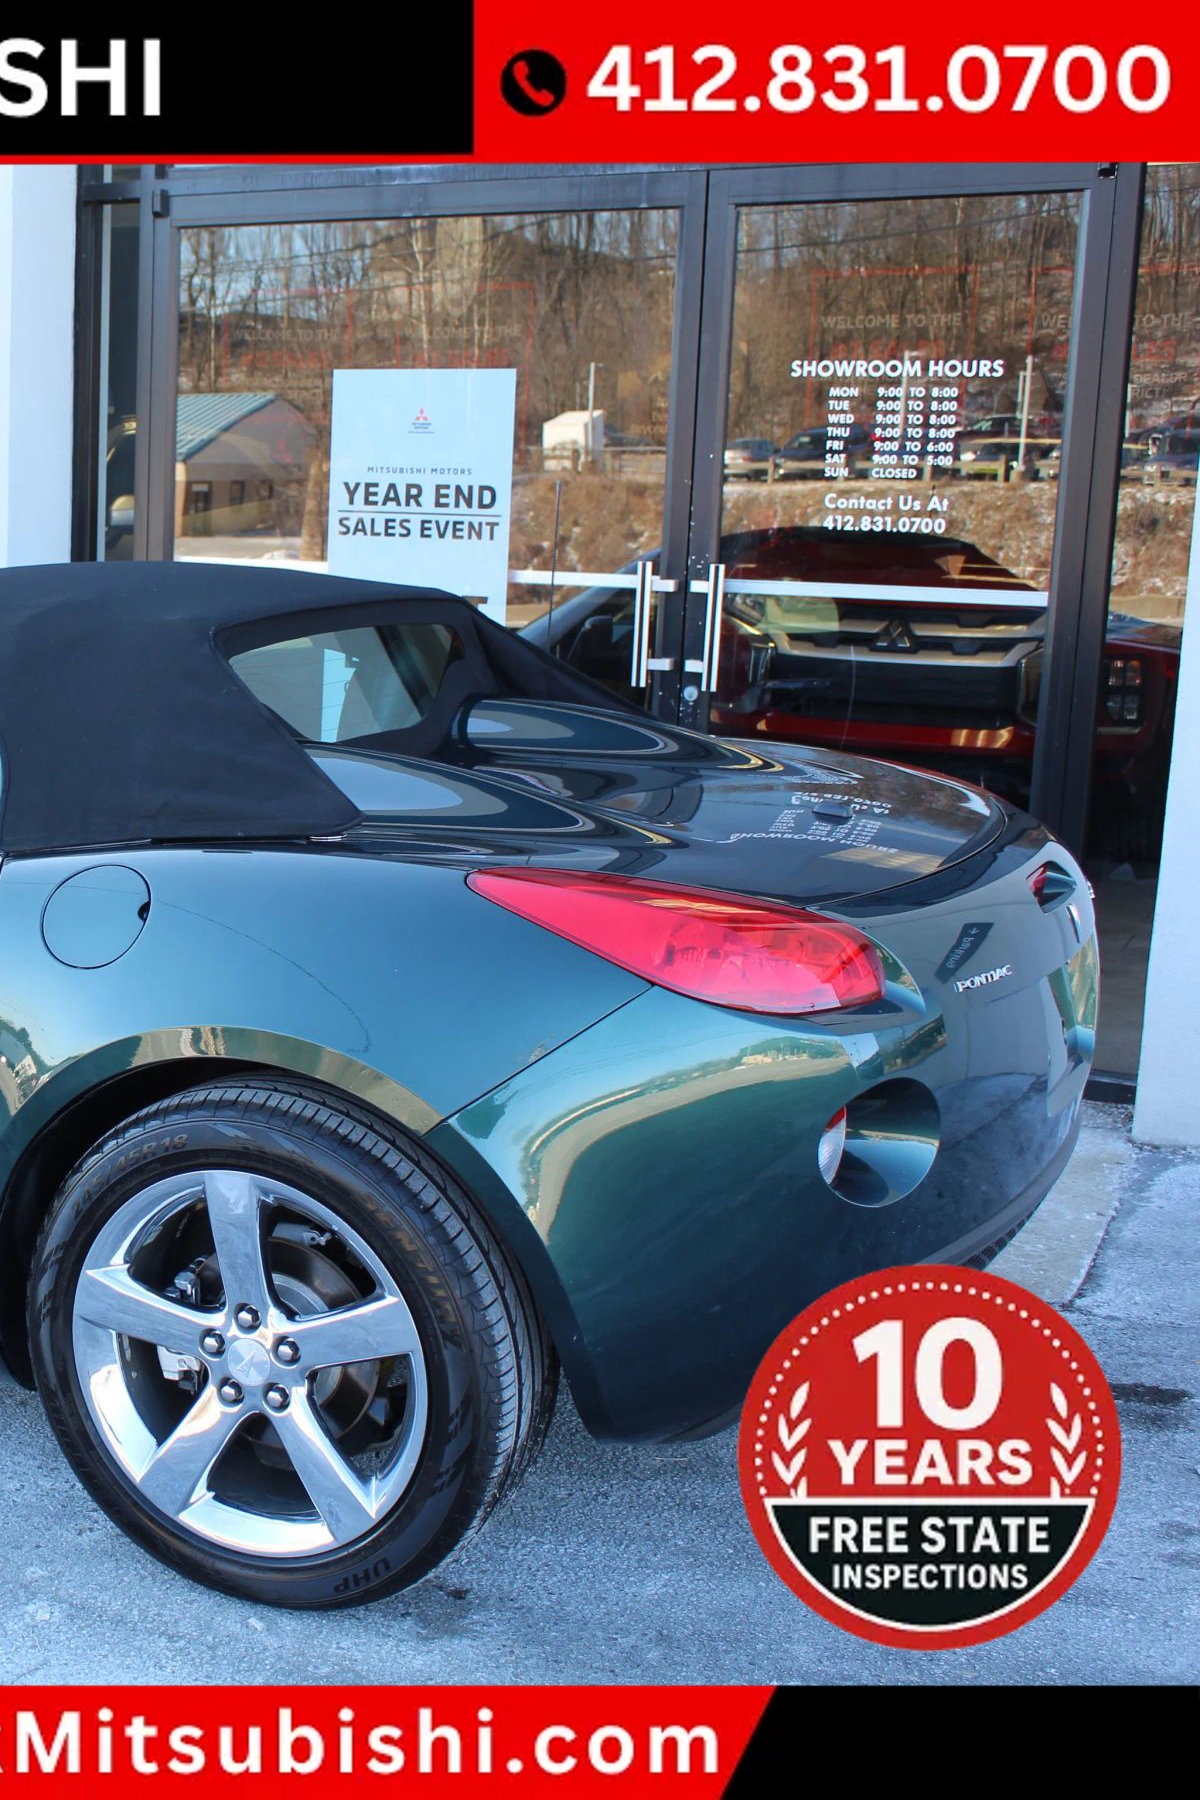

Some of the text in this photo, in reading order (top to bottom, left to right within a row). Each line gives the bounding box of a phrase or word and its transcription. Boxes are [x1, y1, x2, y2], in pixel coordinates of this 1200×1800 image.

[790, 359, 1005, 378] SHOWROOM HOURS
[829, 387, 959, 398] MON 9:00 TO 8:00
[828, 400, 958, 411] TUE 9:00 TO 8:00
[827, 413, 956, 425] WED 9:00 TO 8:00
[826, 427, 955, 439] THU 9:00 TO 8:00
[826, 440, 954, 452] FRI 9:00 TO 6:00
[824, 453, 953, 466] SAT 9:00 TO 5:00
[367, 466, 473, 476] MITSUBISHI MOTORS
[824, 467, 917, 479] SUN CLOSED
[343, 481, 497, 510] YEAR END
[824, 493, 949, 512] Contact Us At
[338, 516, 500, 541] SALES EVENT
[822, 515, 947, 534] 412.831.0700
[955, 964, 1013, 993] PONTIAC
[333, 1556, 391, 1593] UHP
